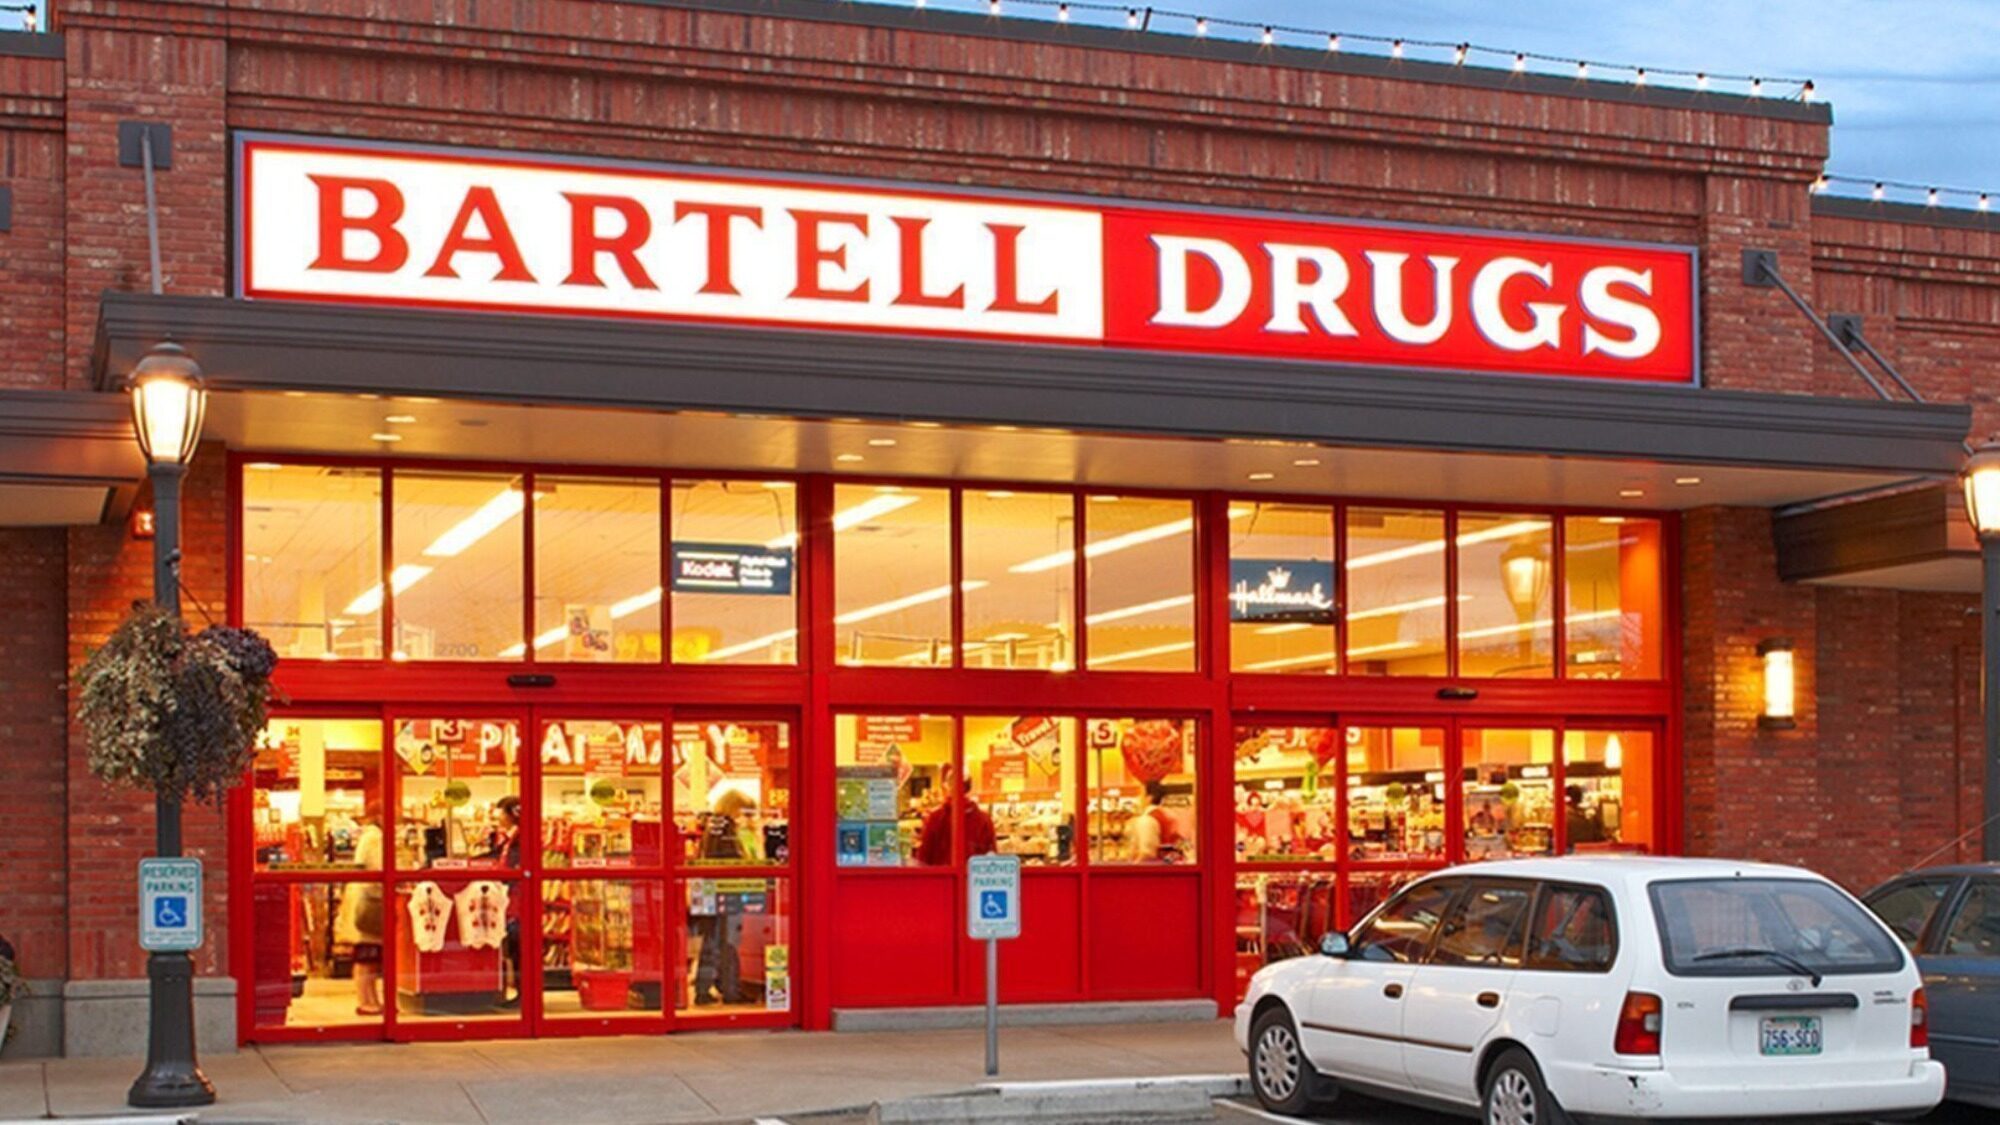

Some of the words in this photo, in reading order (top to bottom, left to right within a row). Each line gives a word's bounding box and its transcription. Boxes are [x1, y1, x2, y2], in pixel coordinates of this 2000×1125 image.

[304, 172, 1060, 317] BARTELL
[1146, 233, 1663, 360] DRUGS
[681, 559, 734, 578] Kodak
[1228, 579, 1334, 616] Hallmark
[146, 881, 195, 893] PARKING
[974, 876, 1014, 888] PARKING
